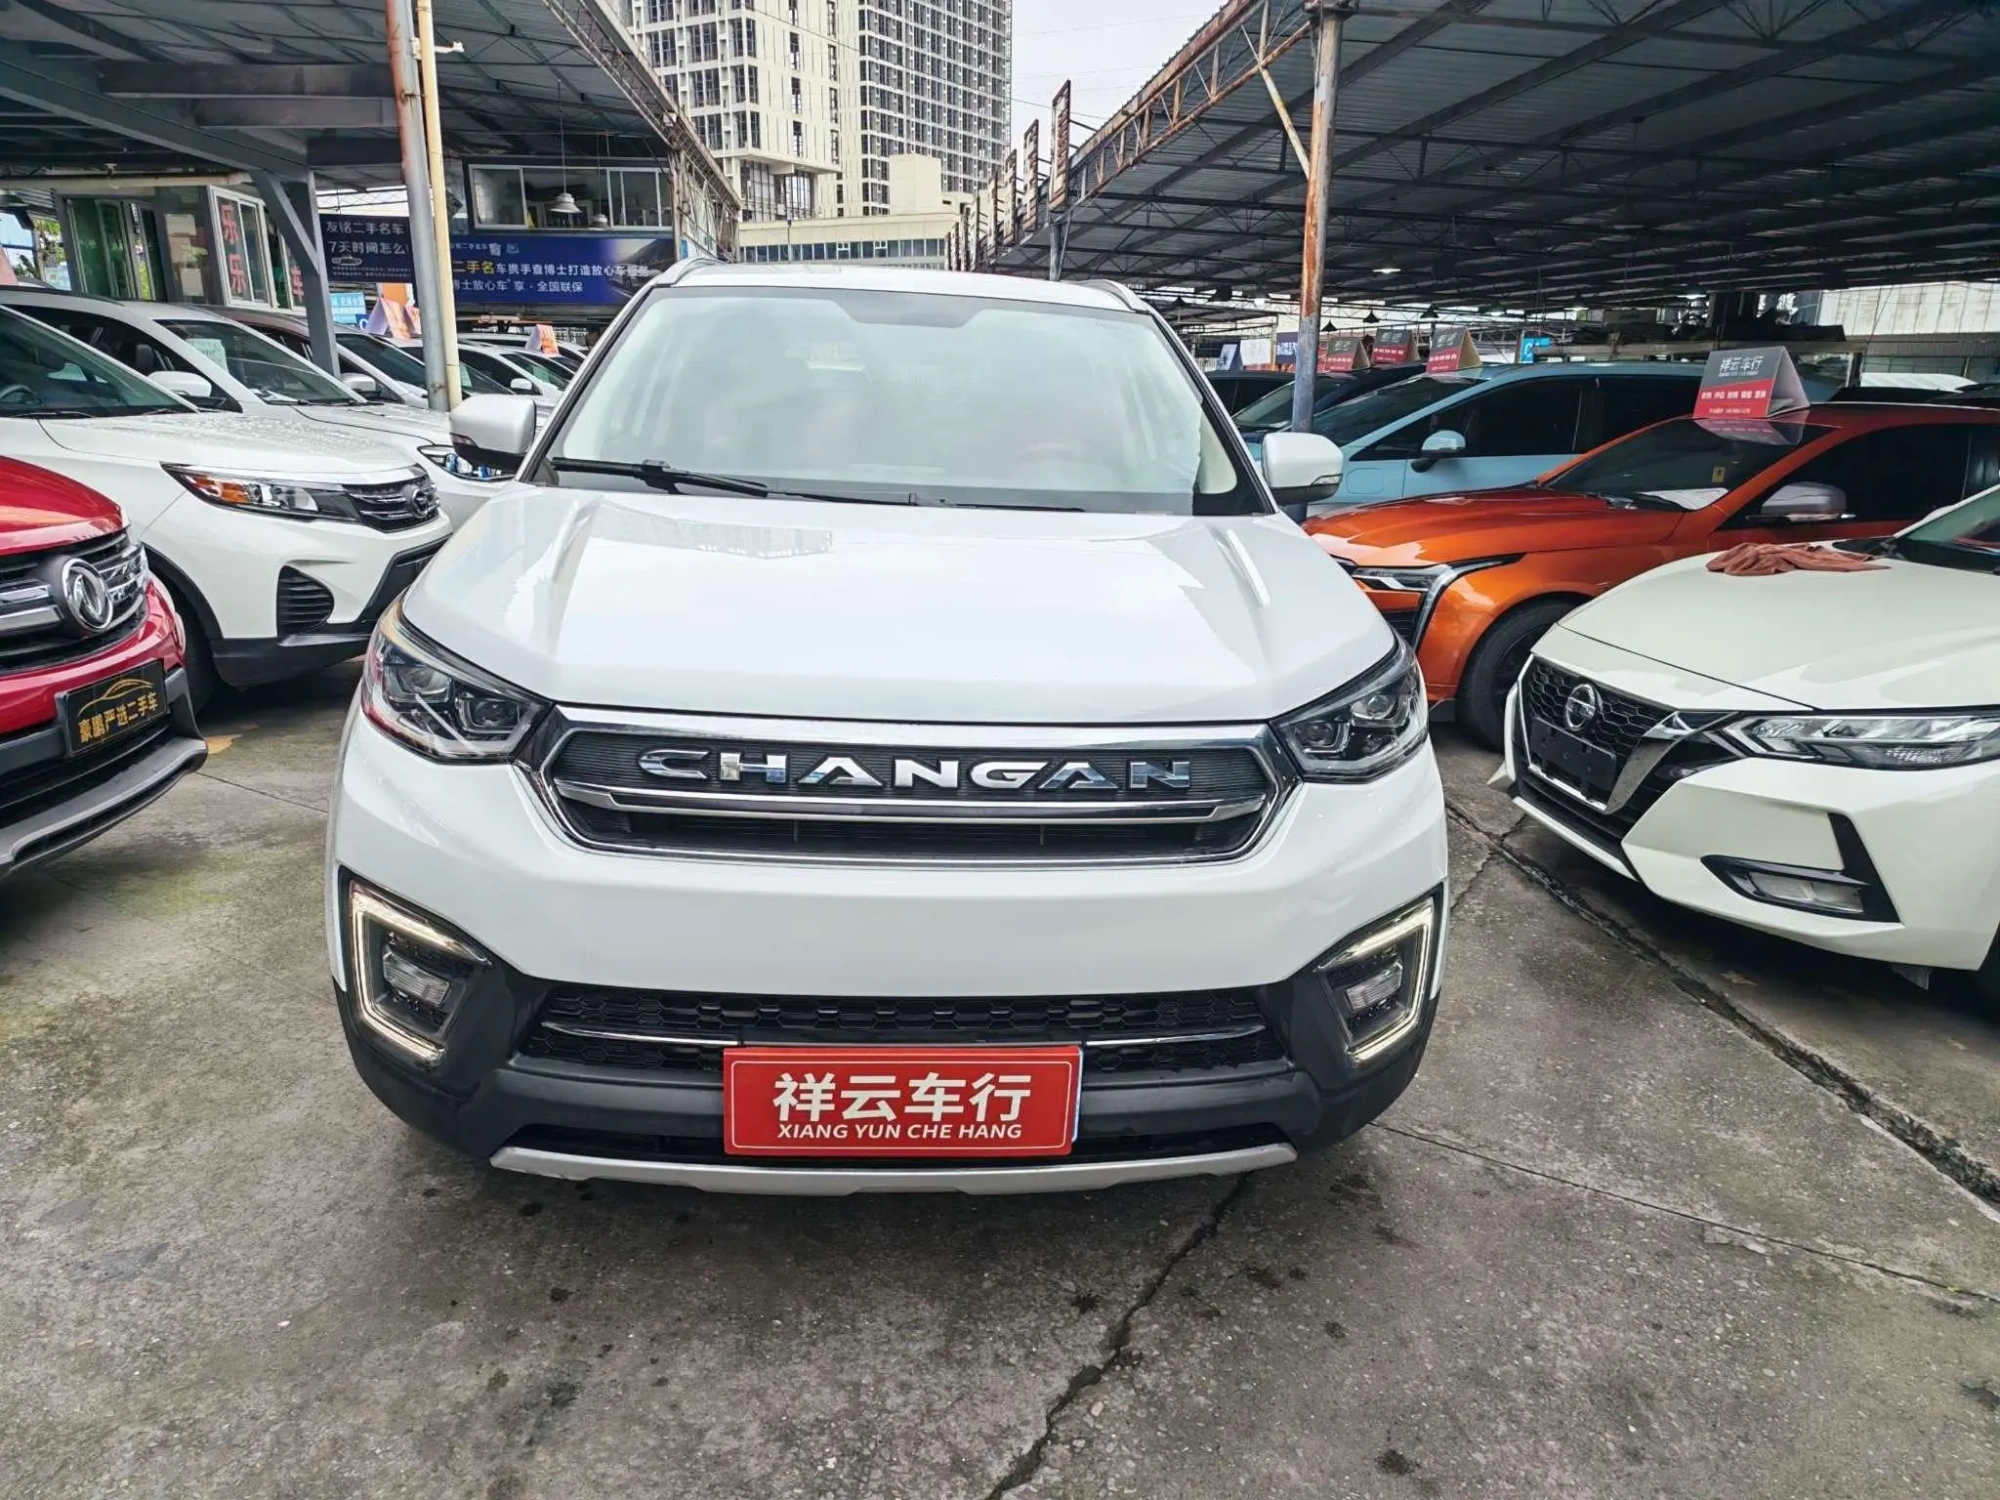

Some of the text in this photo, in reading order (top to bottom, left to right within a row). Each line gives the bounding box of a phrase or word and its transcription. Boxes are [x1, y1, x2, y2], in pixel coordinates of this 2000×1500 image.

[328, 241, 409, 255] 7天时间怎么
[1719, 355, 1764, 372] 祥云车行
[638, 749, 1191, 789] CHANGAN
[772, 1072, 1032, 1122] 祥云车行
[777, 1123, 1023, 1139] XIANG YUN CHE HANG
